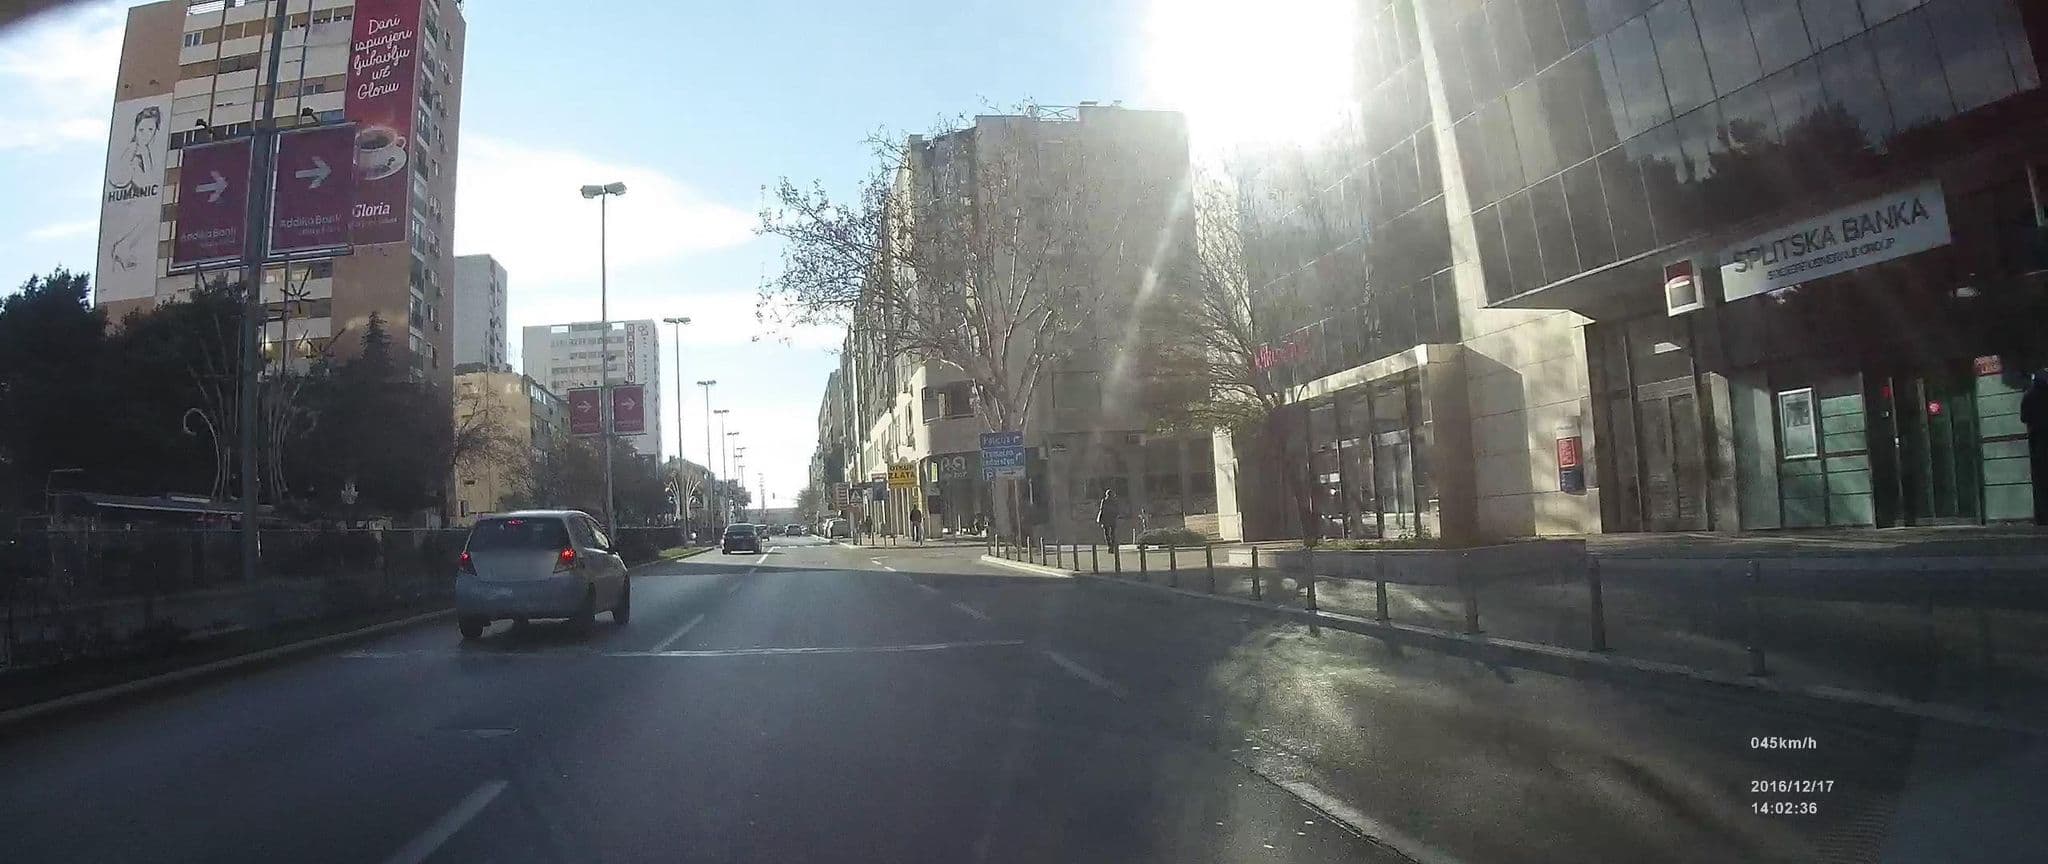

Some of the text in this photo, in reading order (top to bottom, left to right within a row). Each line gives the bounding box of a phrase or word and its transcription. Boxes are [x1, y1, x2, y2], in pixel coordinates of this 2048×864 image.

[369, 15, 401, 35] Dani
[354, 45, 410, 76] ljubavlju
[108, 184, 159, 202] HUMANIC
[352, 202, 391, 218] Gloria
[1733, 197, 1931, 274] SPLITSKA BANKA
[888, 471, 915, 480] ZLATA
